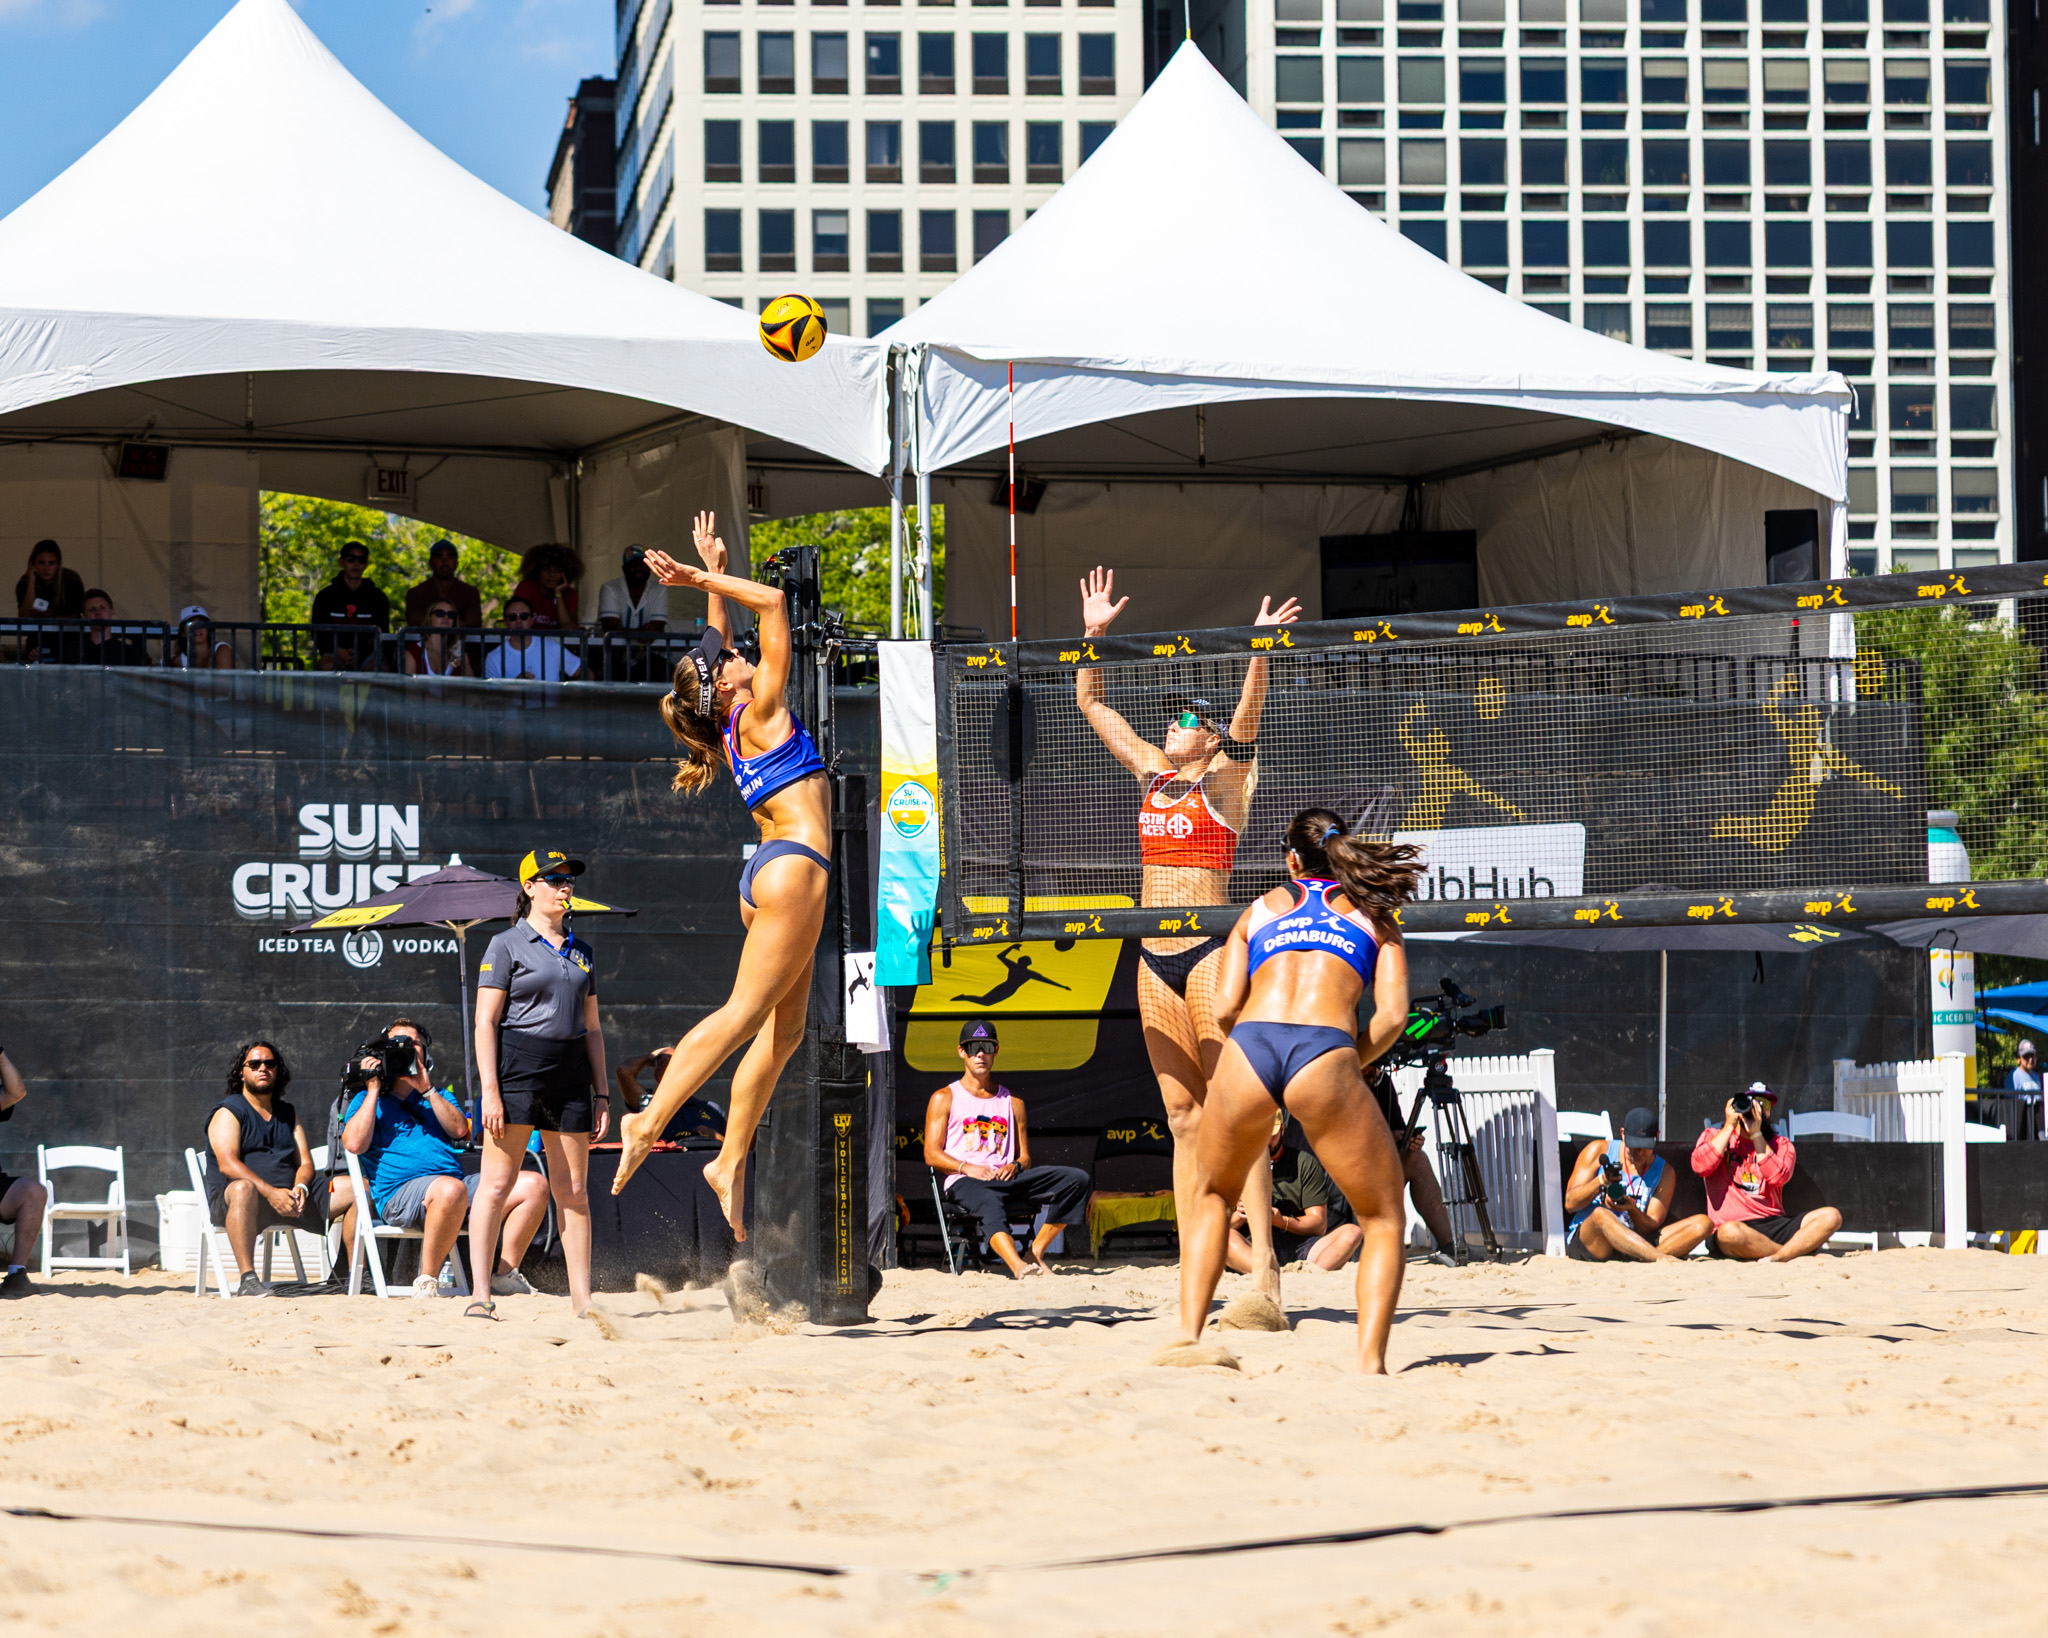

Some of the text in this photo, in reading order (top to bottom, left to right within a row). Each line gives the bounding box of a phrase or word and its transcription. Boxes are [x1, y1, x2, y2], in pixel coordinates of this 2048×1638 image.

[378, 469, 408, 494] EXIT
[1917, 584, 1947, 600] avp
[1796, 594, 1824, 610] avp
[1679, 604, 1705, 619] avp
[1566, 613, 1593, 628] avp
[1353, 629, 1377, 643] avp
[1457, 621, 1484, 636] avp
[1153, 643, 1176, 657] avp
[1250, 636, 1274, 650] avp
[966, 655, 988, 669] avp
[1058, 650, 1081, 664] avp
[1139, 812, 1166, 825] USTIN
[298, 803, 420, 855] SUN
[1142, 824, 1166, 836] ACES
[232, 862, 444, 914] CRUIS
[1308, 881, 1324, 892] 2
[1413, 866, 1555, 900] ubHub
[1804, 900, 1833, 917] avp
[1925, 896, 1955, 912] avp
[1464, 911, 1491, 927] avp
[1573, 908, 1601, 924] avp
[1687, 904, 1715, 920] avp
[1064, 921, 1087, 936] avp
[1158, 919, 1182, 934] avp
[1277, 917, 1313, 931] avp
[972, 926, 995, 940] avp
[259, 938, 336, 953] ICED TEA
[391, 939, 459, 953] VODKA
[1263, 930, 1356, 954] DENABURG
[895, 1136, 908, 1149] vp
[1106, 1129, 1137, 1144] avp
